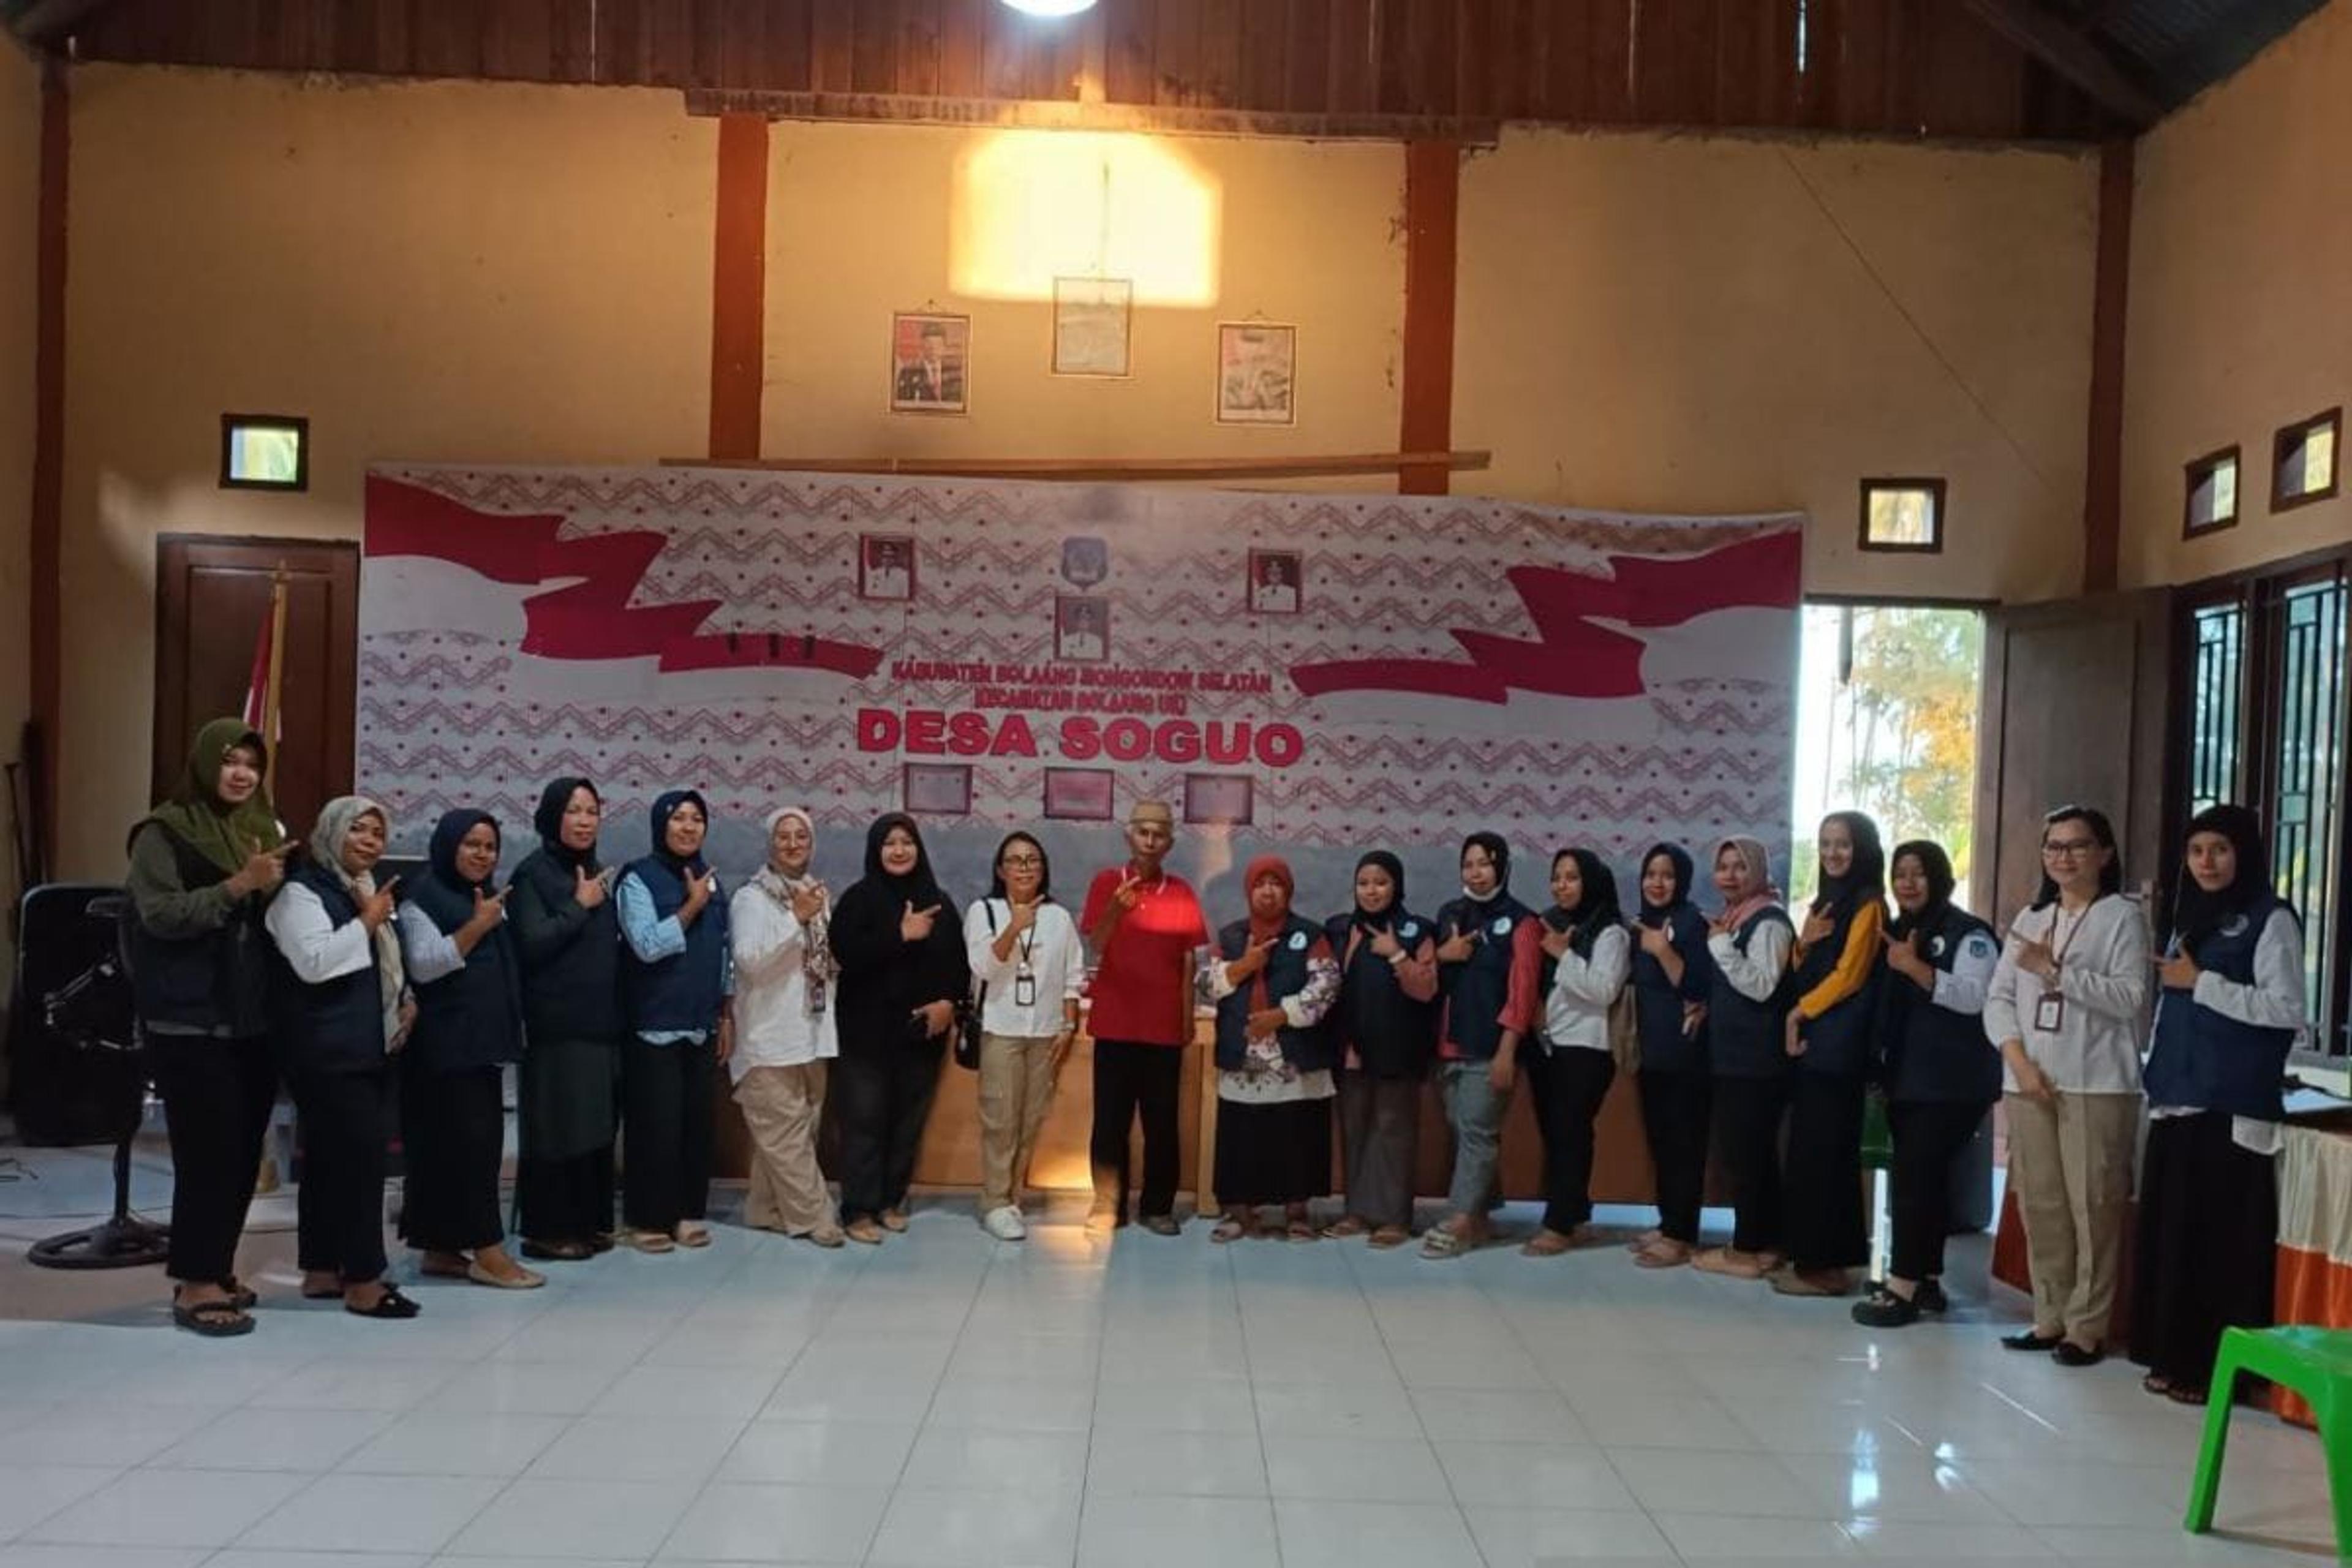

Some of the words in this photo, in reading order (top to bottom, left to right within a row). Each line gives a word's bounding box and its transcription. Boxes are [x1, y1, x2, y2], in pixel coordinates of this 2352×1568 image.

[892, 660, 992, 682] KABUPATEN
[997, 663, 1076, 685] BOLAANG
[1199, 671, 1272, 693] SELATAN
[858, 709, 1039, 758] DESA
[1060, 715, 1305, 768] SOGUO
